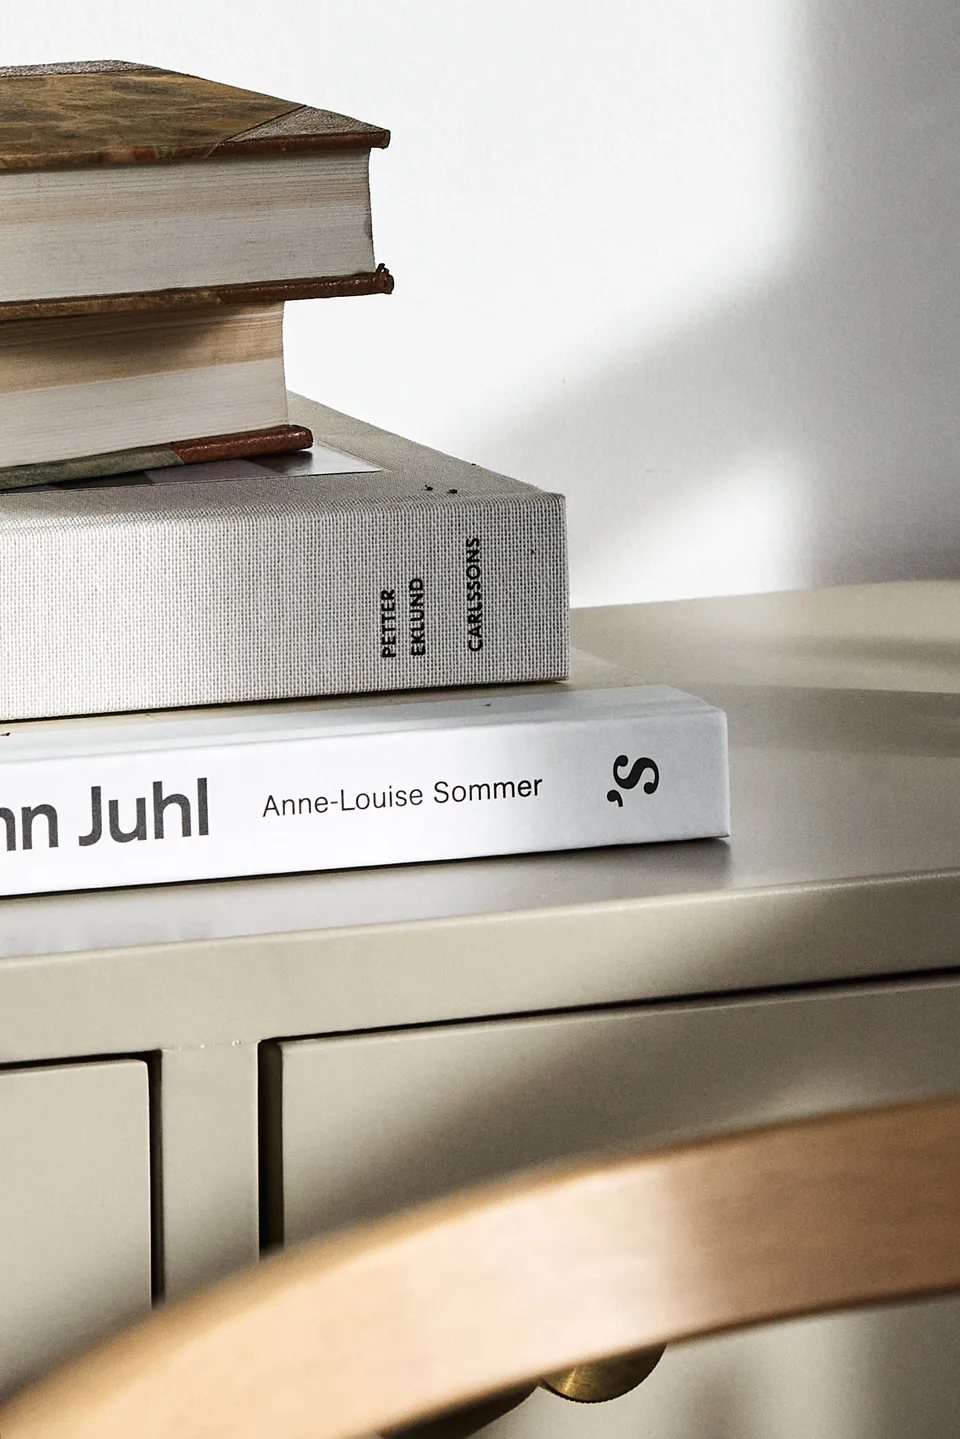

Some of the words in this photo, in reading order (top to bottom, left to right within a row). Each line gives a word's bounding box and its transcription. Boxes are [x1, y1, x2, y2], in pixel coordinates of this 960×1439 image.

[380, 588, 398, 659] PETTER
[408, 577, 427, 657] EKLUND
[465, 536, 485, 653] CARLSSONS
[78, 777, 209, 847] Juhl
[262, 785, 423, 818] Anne-Louise
[433, 778, 543, 804] Sommer
